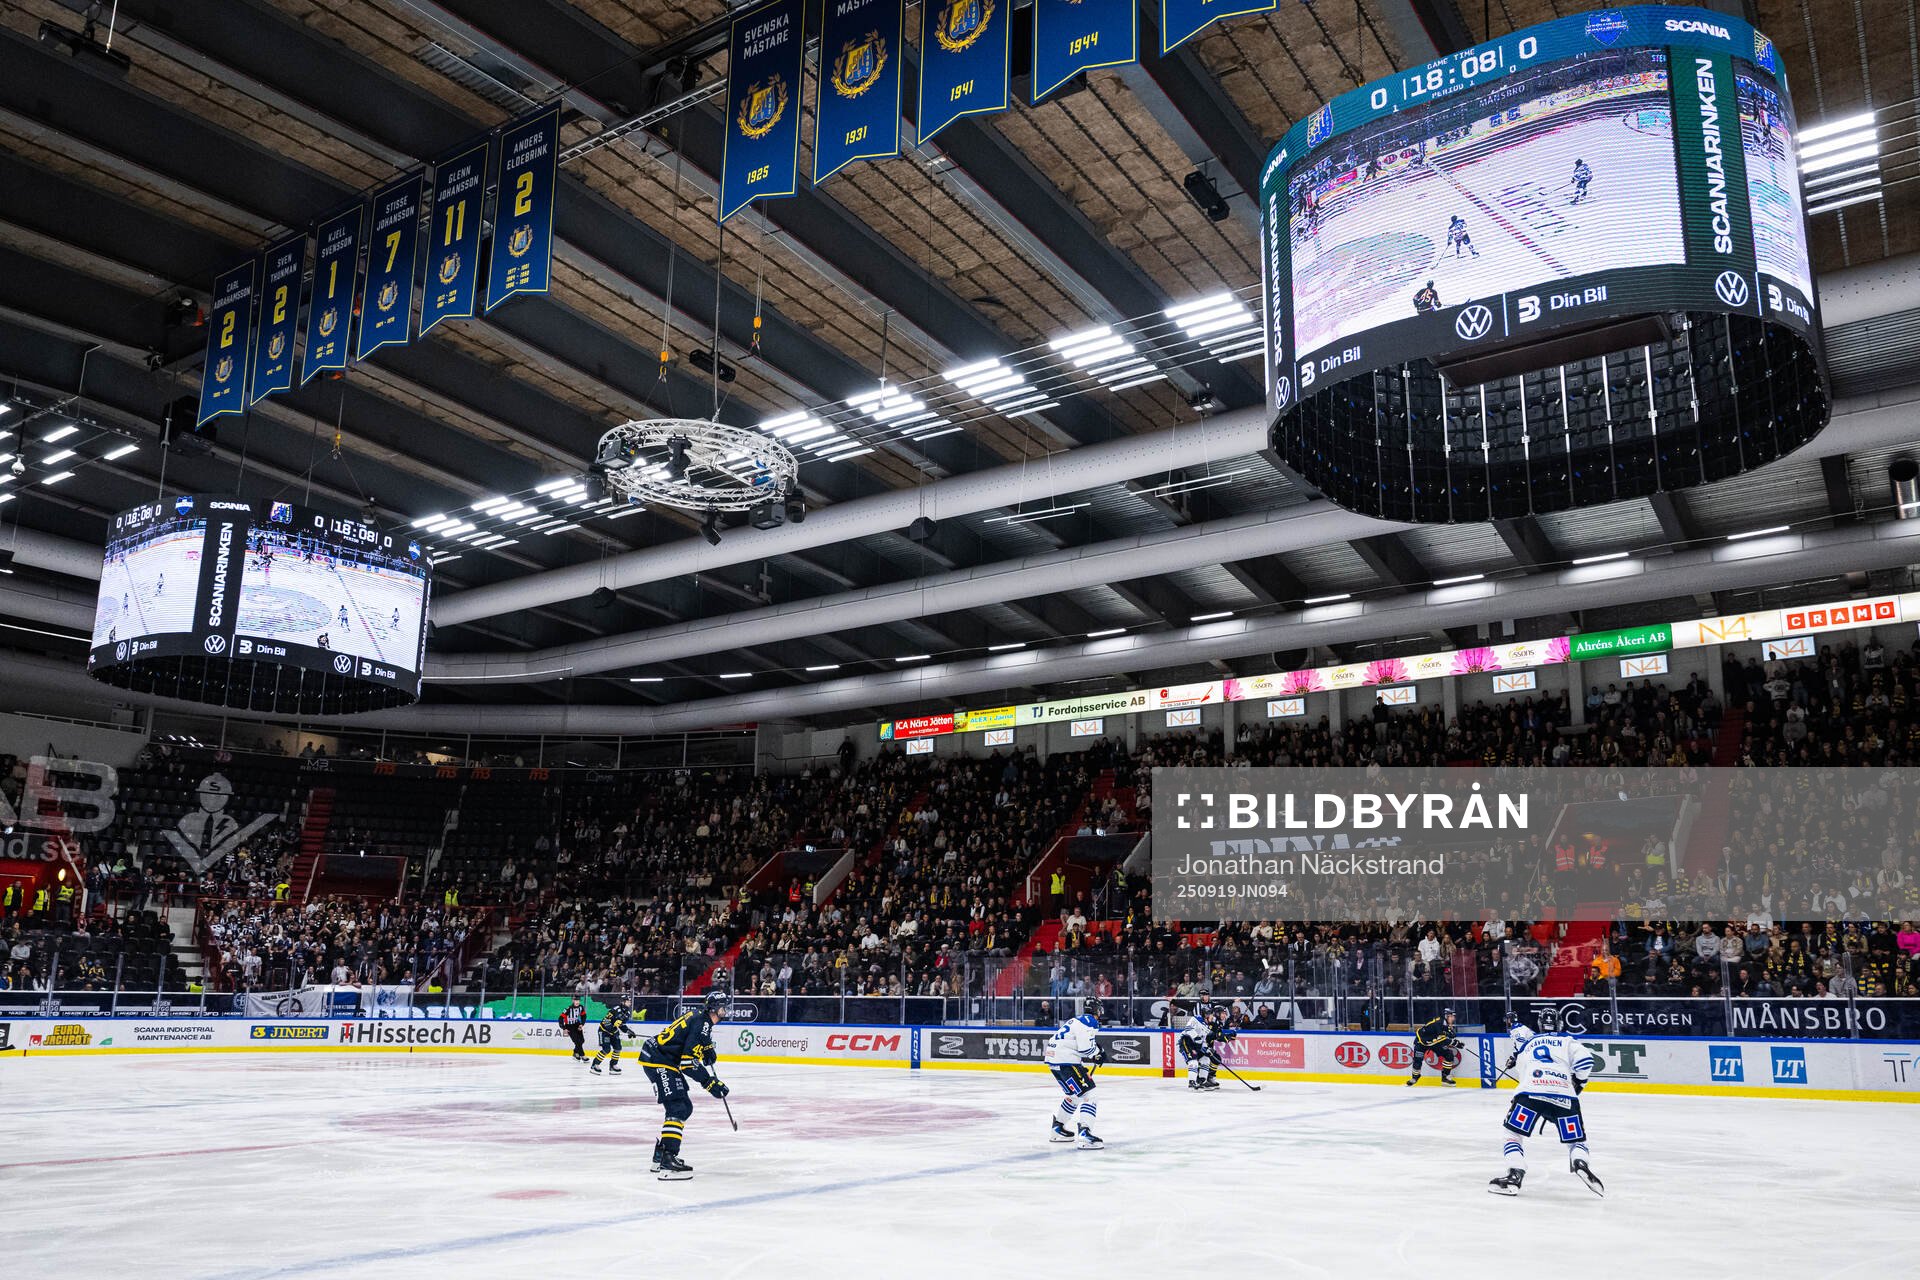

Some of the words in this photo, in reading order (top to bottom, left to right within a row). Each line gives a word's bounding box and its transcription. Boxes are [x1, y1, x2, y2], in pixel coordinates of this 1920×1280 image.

[744, 13, 789, 43] SVENSKA
[1664, 19, 1730, 40] SCANIA
[744, 29, 789, 60] MÄSTARE
[1070, 32, 1098, 56] 1944
[1518, 36, 1537, 60] 0
[1427, 58, 1448, 70] GAME
[1454, 48, 1475, 60] TIME
[1410, 50, 1496, 98] 18:08
[950, 80, 974, 102] 1941
[1370, 88, 1388, 110] 0
[514, 132, 543, 154] ANDERS
[845, 125, 868, 146] 1931
[506, 144, 548, 170] ELDEBRINK
[1696, 58, 1732, 254] SCANIARINKEN
[448, 165, 472, 184] GLENN
[747, 164, 770, 184] 1925
[1262, 148, 1287, 188] SCANIA
[438, 174, 479, 202] JOHANSSON
[514, 170, 533, 217] 2
[386, 195, 408, 214] STISSE
[376, 205, 415, 231] JOHANSSON
[444, 200, 465, 246] 11
[328, 226, 346, 242] KJELL
[321, 235, 352, 258] SVENSSON
[385, 230, 401, 273] 7
[277, 253, 292, 268] SVEN
[226, 280, 239, 293] CARL
[328, 260, 338, 298] 1
[273, 285, 288, 325] 2
[1550, 291, 1580, 310] Din
[1584, 286, 1608, 306] Bil
[1786, 296, 1803, 319] Din
[220, 310, 236, 349] 2
[1321, 354, 1340, 373] Din
[1343, 346, 1360, 364] Bil
[126, 509, 150, 526] 18:08
[210, 502, 250, 512] SCANIA
[314, 516, 324, 528] 0
[334, 520, 375, 543] 18:08
[384, 536, 392, 548] 0
[209, 522, 233, 627] SCANIARINKEN
[1790, 604, 1891, 628] CRAMO
[1699, 616, 1752, 644] N4
[140, 642, 150, 650] Din
[257, 644, 273, 654] Din
[274, 647, 286, 656] Bil
[1576, 637, 1613, 653] Ahréns
[1616, 634, 1646, 648] Åkeri
[1649, 632, 1666, 642] AB
[1768, 639, 1808, 657] N4
[375, 668, 386, 677] Din
[387, 670, 396, 679] Bil
[1626, 657, 1662, 676] N4
[1498, 675, 1531, 691] N4
[1382, 688, 1411, 703] N4
[1032, 706, 1043, 718] TJ
[1048, 698, 1127, 717] Fordonsservice
[1130, 696, 1146, 706] AB
[1272, 702, 1301, 716] N4
[896, 720, 909, 730] ICA
[910, 718, 929, 729] Nära
[930, 716, 953, 727] Jätten
[1073, 720, 1098, 735] N4
[1170, 711, 1196, 725] N4
[910, 740, 930, 752] N4
[988, 732, 1010, 745] N4
[1592, 1011, 1692, 1025] FÖRETAGEN
[1733, 1002, 1886, 1030] MÅNSBRO
[43, 1034, 92, 1046] JACKPOT
[54, 1024, 84, 1035] EURO
[270, 1027, 327, 1038] JINERT
[358, 1022, 457, 1044] Hisstech
[462, 1024, 491, 1044] AB
[527, 1029, 552, 1037] J.E.G
[756, 1035, 808, 1050] Söderenergi
[826, 1035, 901, 1051] CCM
[1257, 1049, 1291, 1057] försäljning
[1222, 1056, 1248, 1065] media
[1337, 1045, 1368, 1064] JB
[1380, 1045, 1413, 1064] JB
[1483, 1039, 1492, 1076] CCM
[1712, 1058, 1741, 1076] LT
[1774, 1060, 1804, 1078] LT
